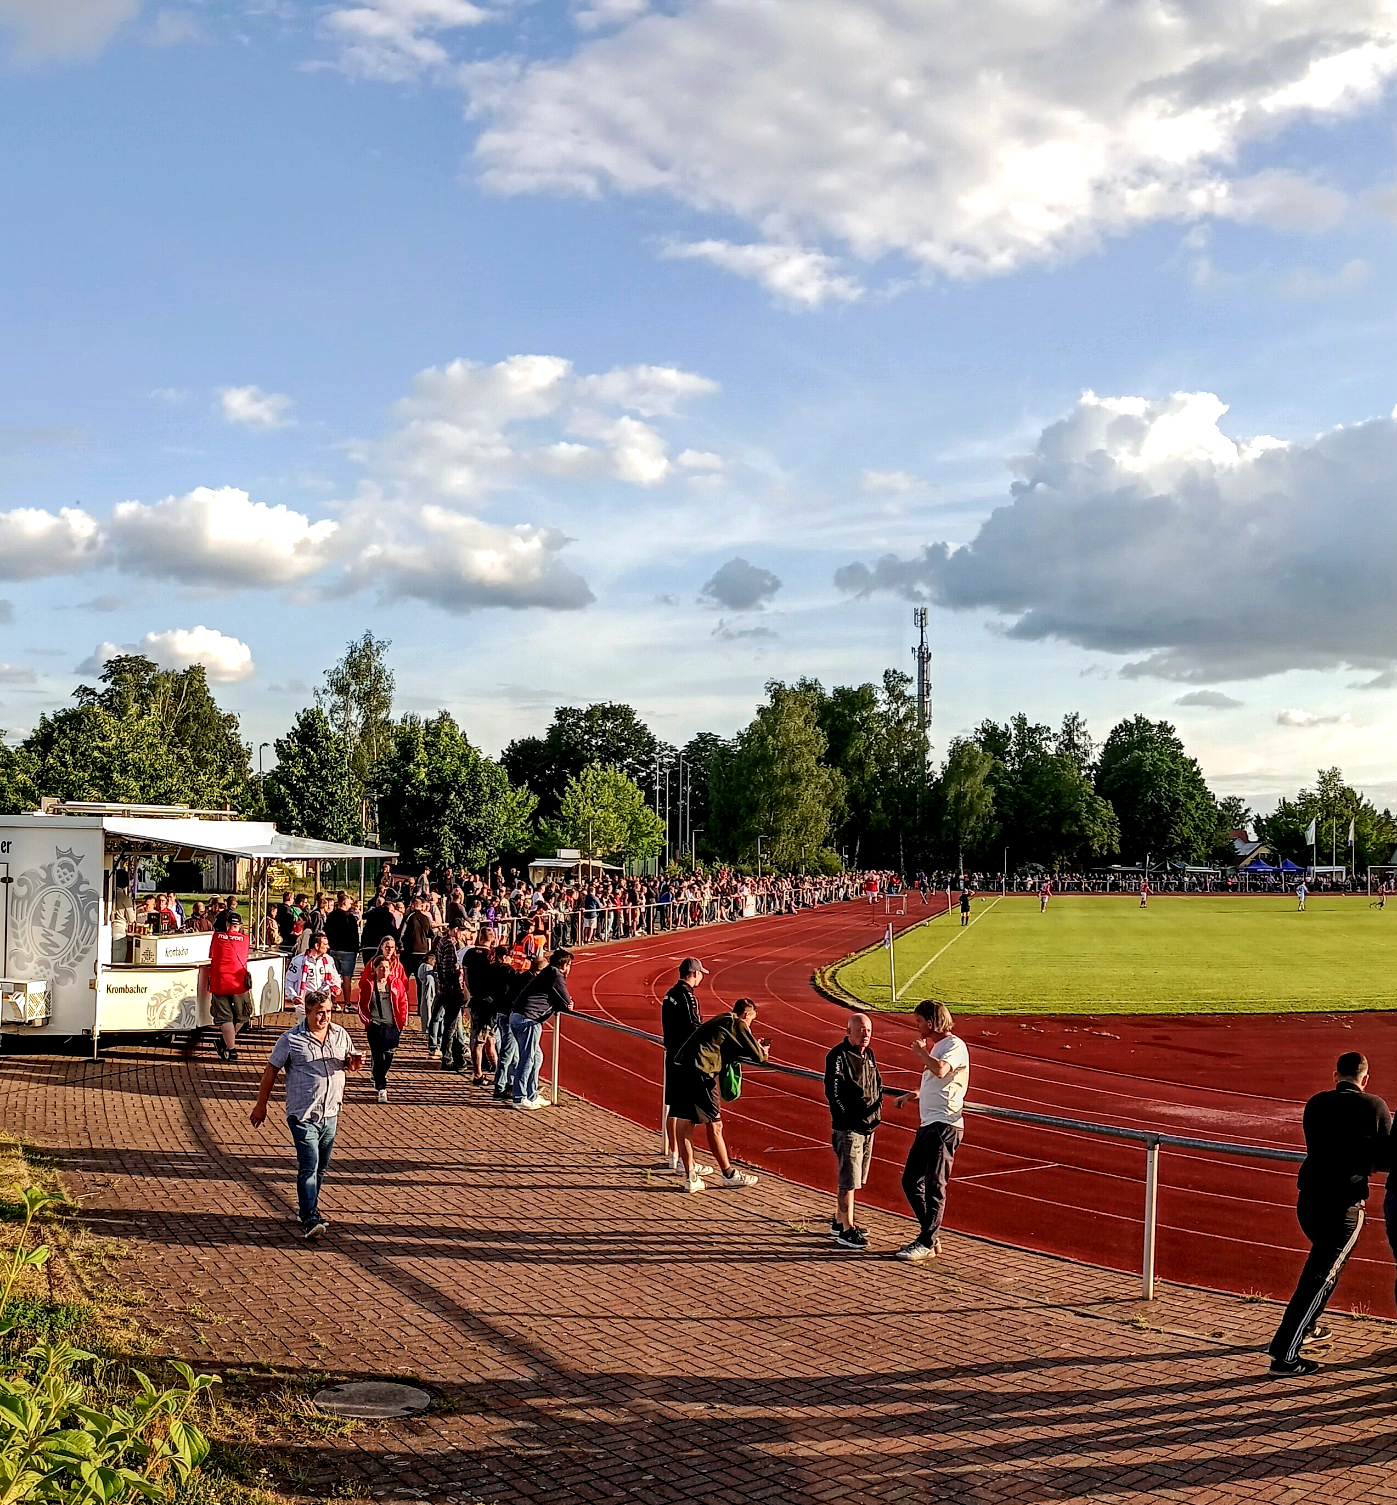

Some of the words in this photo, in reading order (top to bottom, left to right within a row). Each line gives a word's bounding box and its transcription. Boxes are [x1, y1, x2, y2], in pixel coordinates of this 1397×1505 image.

[1, 841, 12, 853] er
[288, 963, 298, 974] 25
[106, 984, 148, 994] Krombacher
